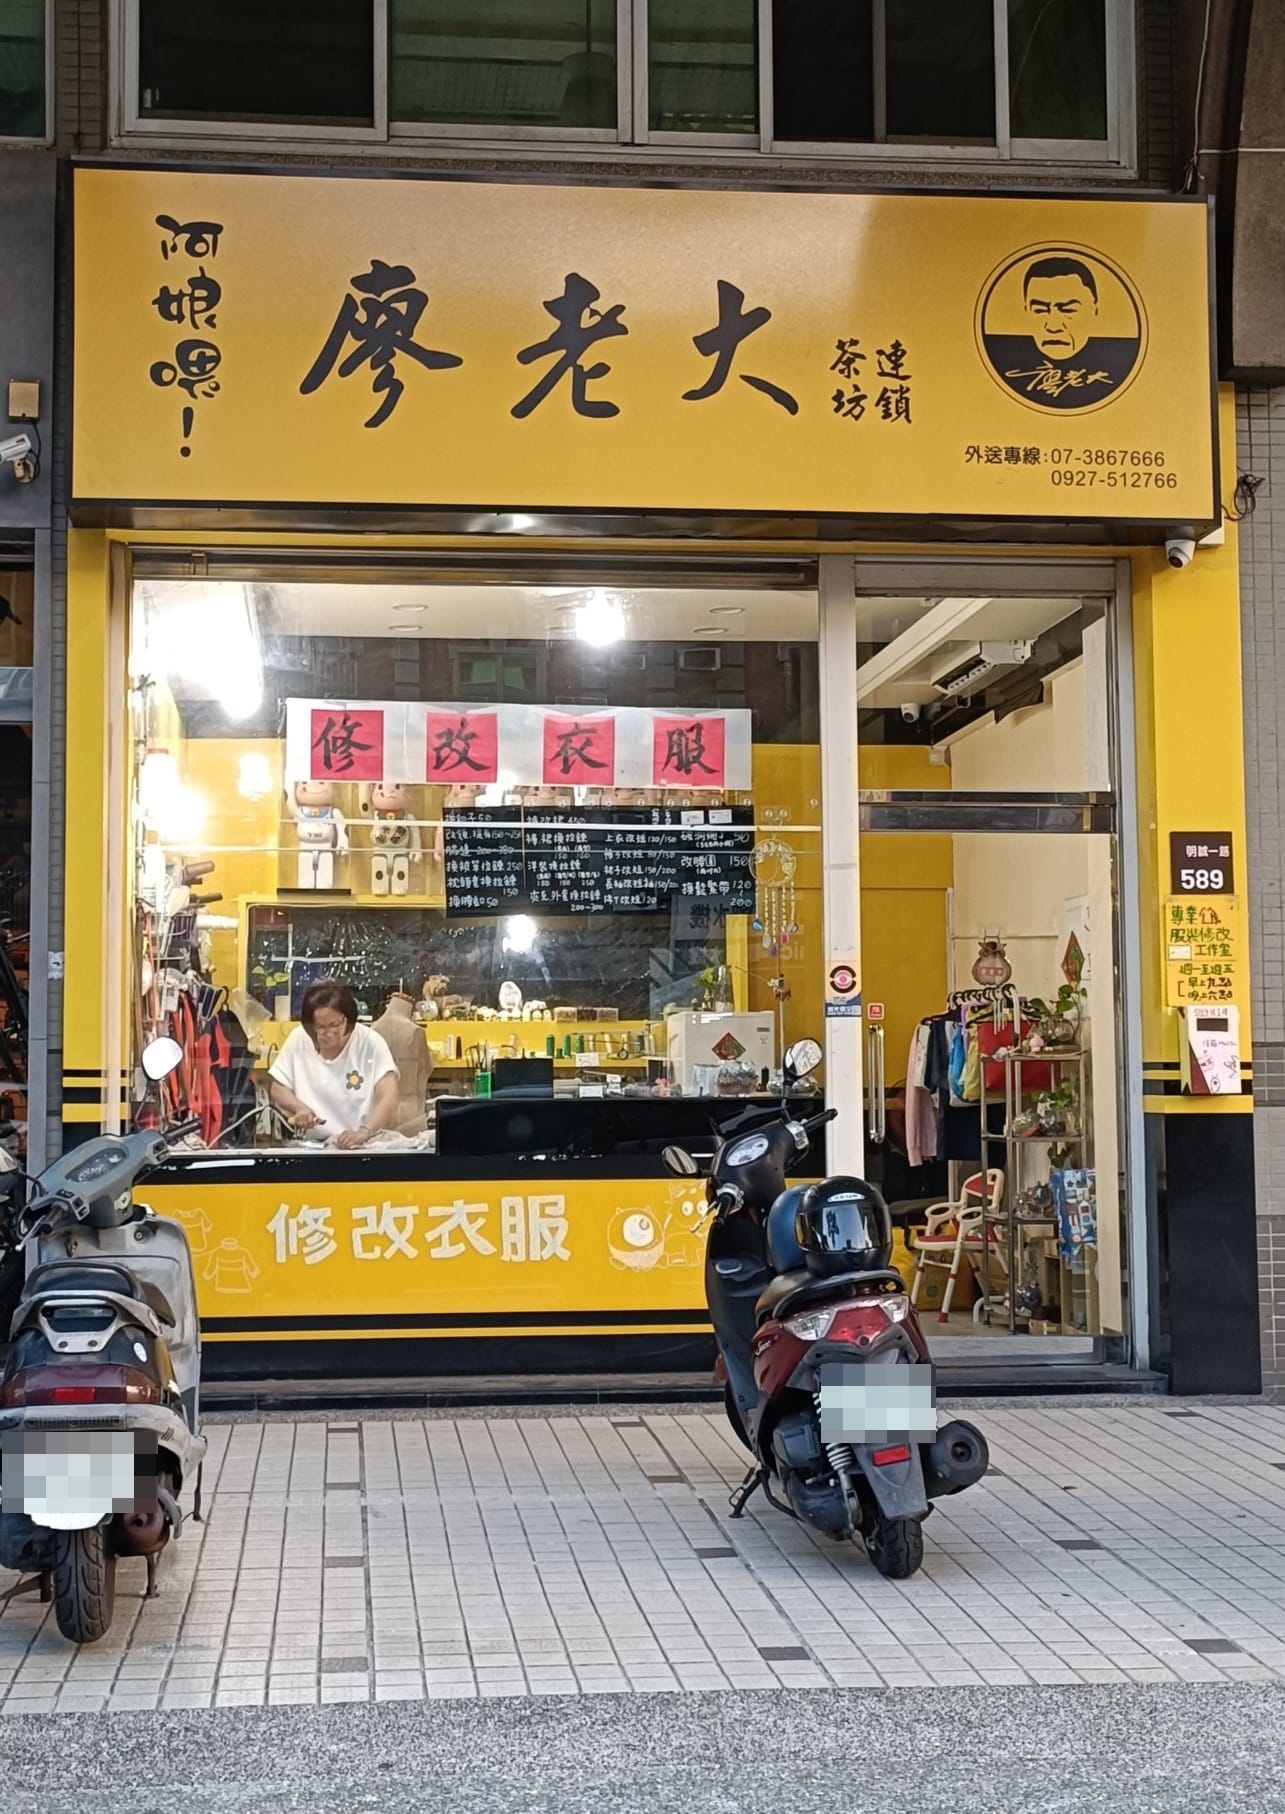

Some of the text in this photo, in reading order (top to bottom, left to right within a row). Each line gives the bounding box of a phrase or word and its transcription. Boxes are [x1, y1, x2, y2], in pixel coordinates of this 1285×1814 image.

[300, 260, 798, 428] 廖老大
[829, 338, 867, 421] 茶坊
[875, 340, 912, 423] 連鎖
[1051, 470, 1177, 489] 0927-512766
[313, 712, 721, 777] 修改衣服
[1180, 869, 1224, 890] 589
[1179, 963, 1235, 975] 週一至週五
[1195, 944, 1232, 957] 工作室
[267, 1194, 572, 1266] 修改衣服
